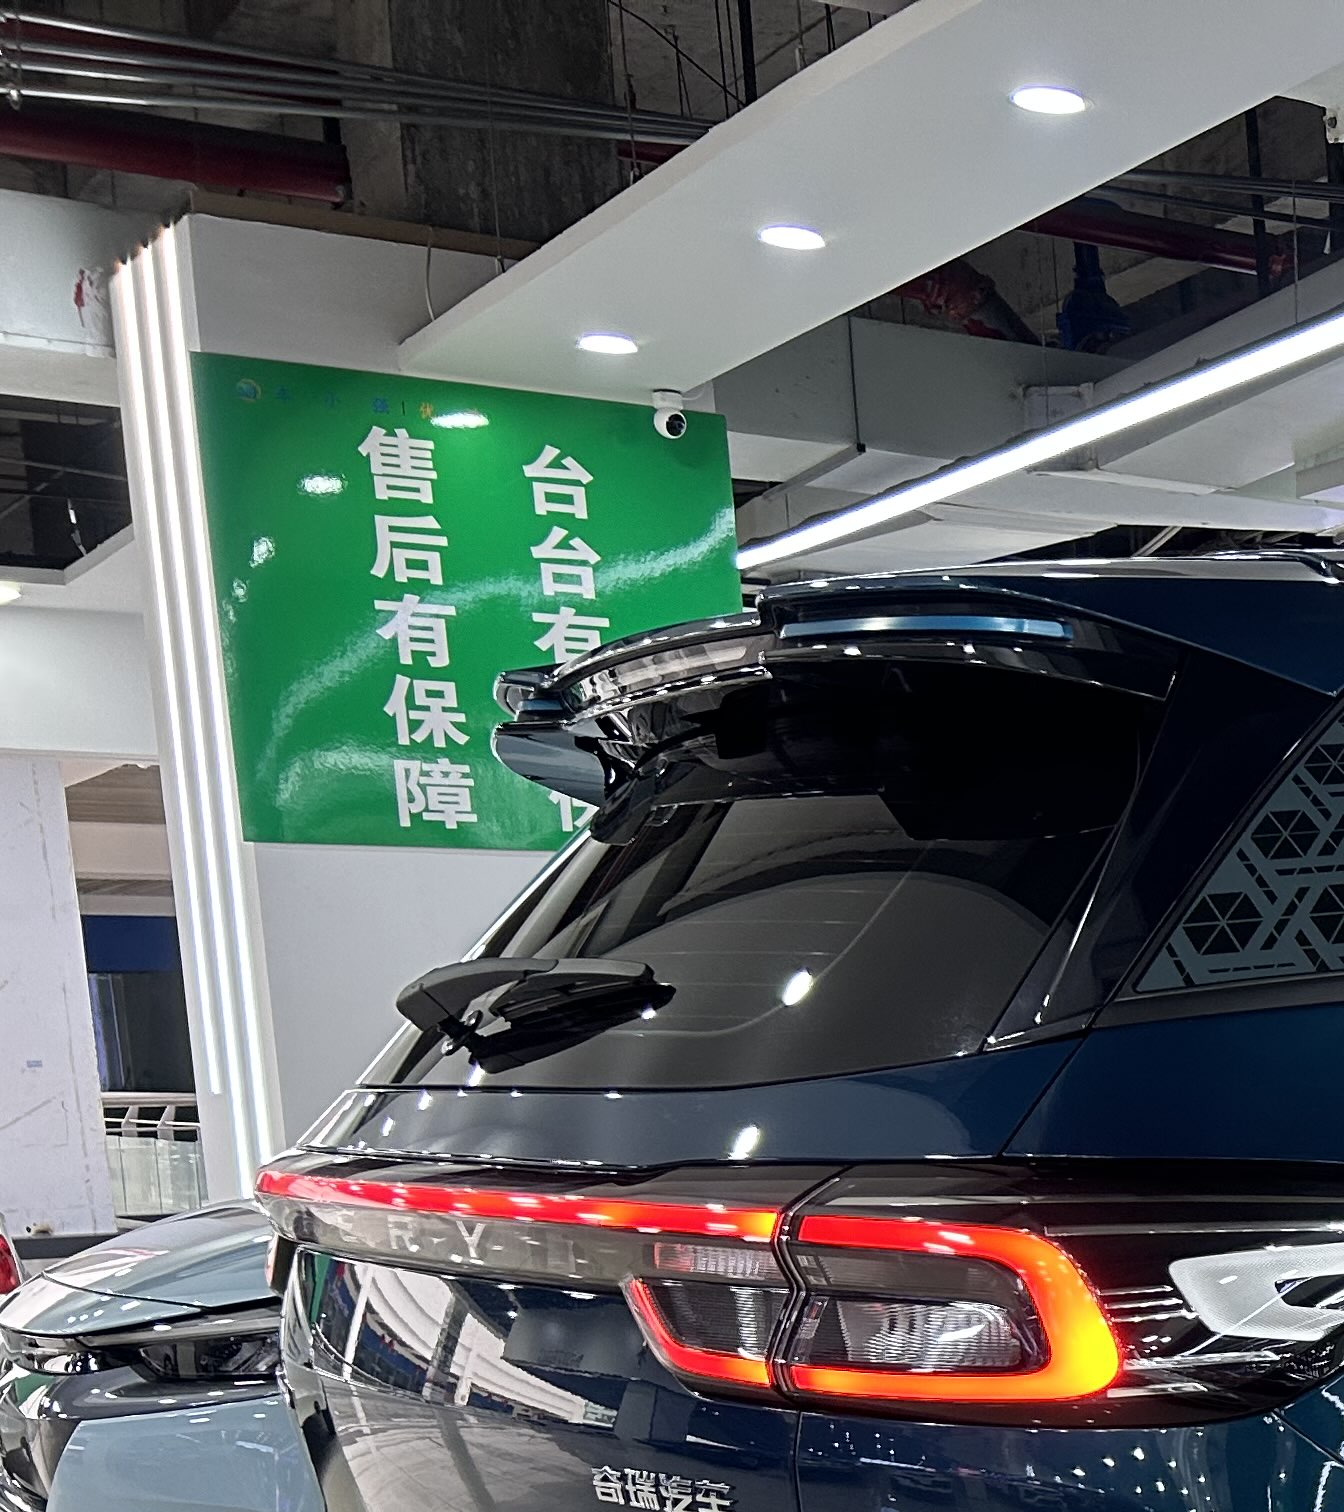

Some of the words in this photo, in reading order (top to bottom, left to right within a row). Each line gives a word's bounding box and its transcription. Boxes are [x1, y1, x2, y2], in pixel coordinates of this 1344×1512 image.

[358, 425, 479, 829] 售后有保障
[522, 445, 610, 832] 台台有
